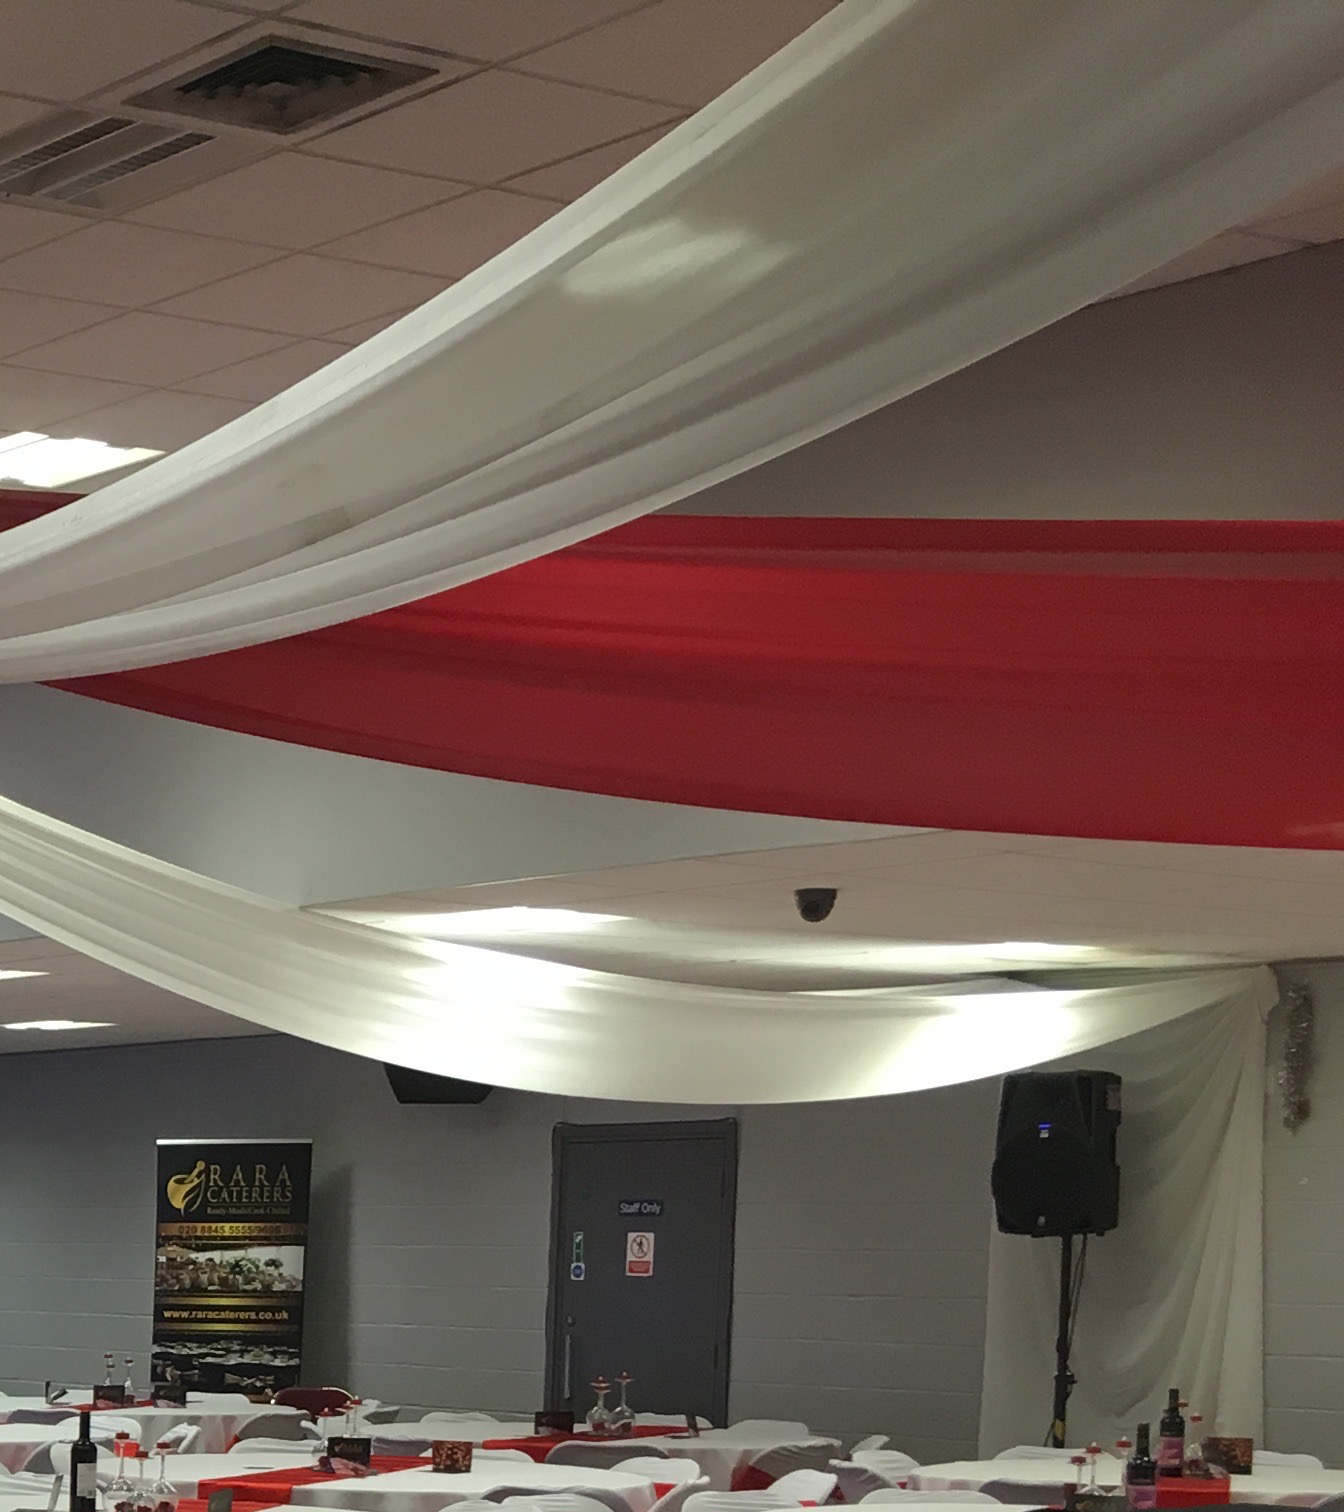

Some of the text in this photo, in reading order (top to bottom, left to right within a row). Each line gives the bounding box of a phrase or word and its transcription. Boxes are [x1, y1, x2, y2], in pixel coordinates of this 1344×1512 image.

[208, 1164, 292, 1186] RARA
[207, 1187, 293, 1203] CATERERS
[619, 1202, 662, 1215] Staff Only
[178, 1225, 197, 1235] 020
[163, 1309, 289, 1320] www.raracaterers.co.uk
